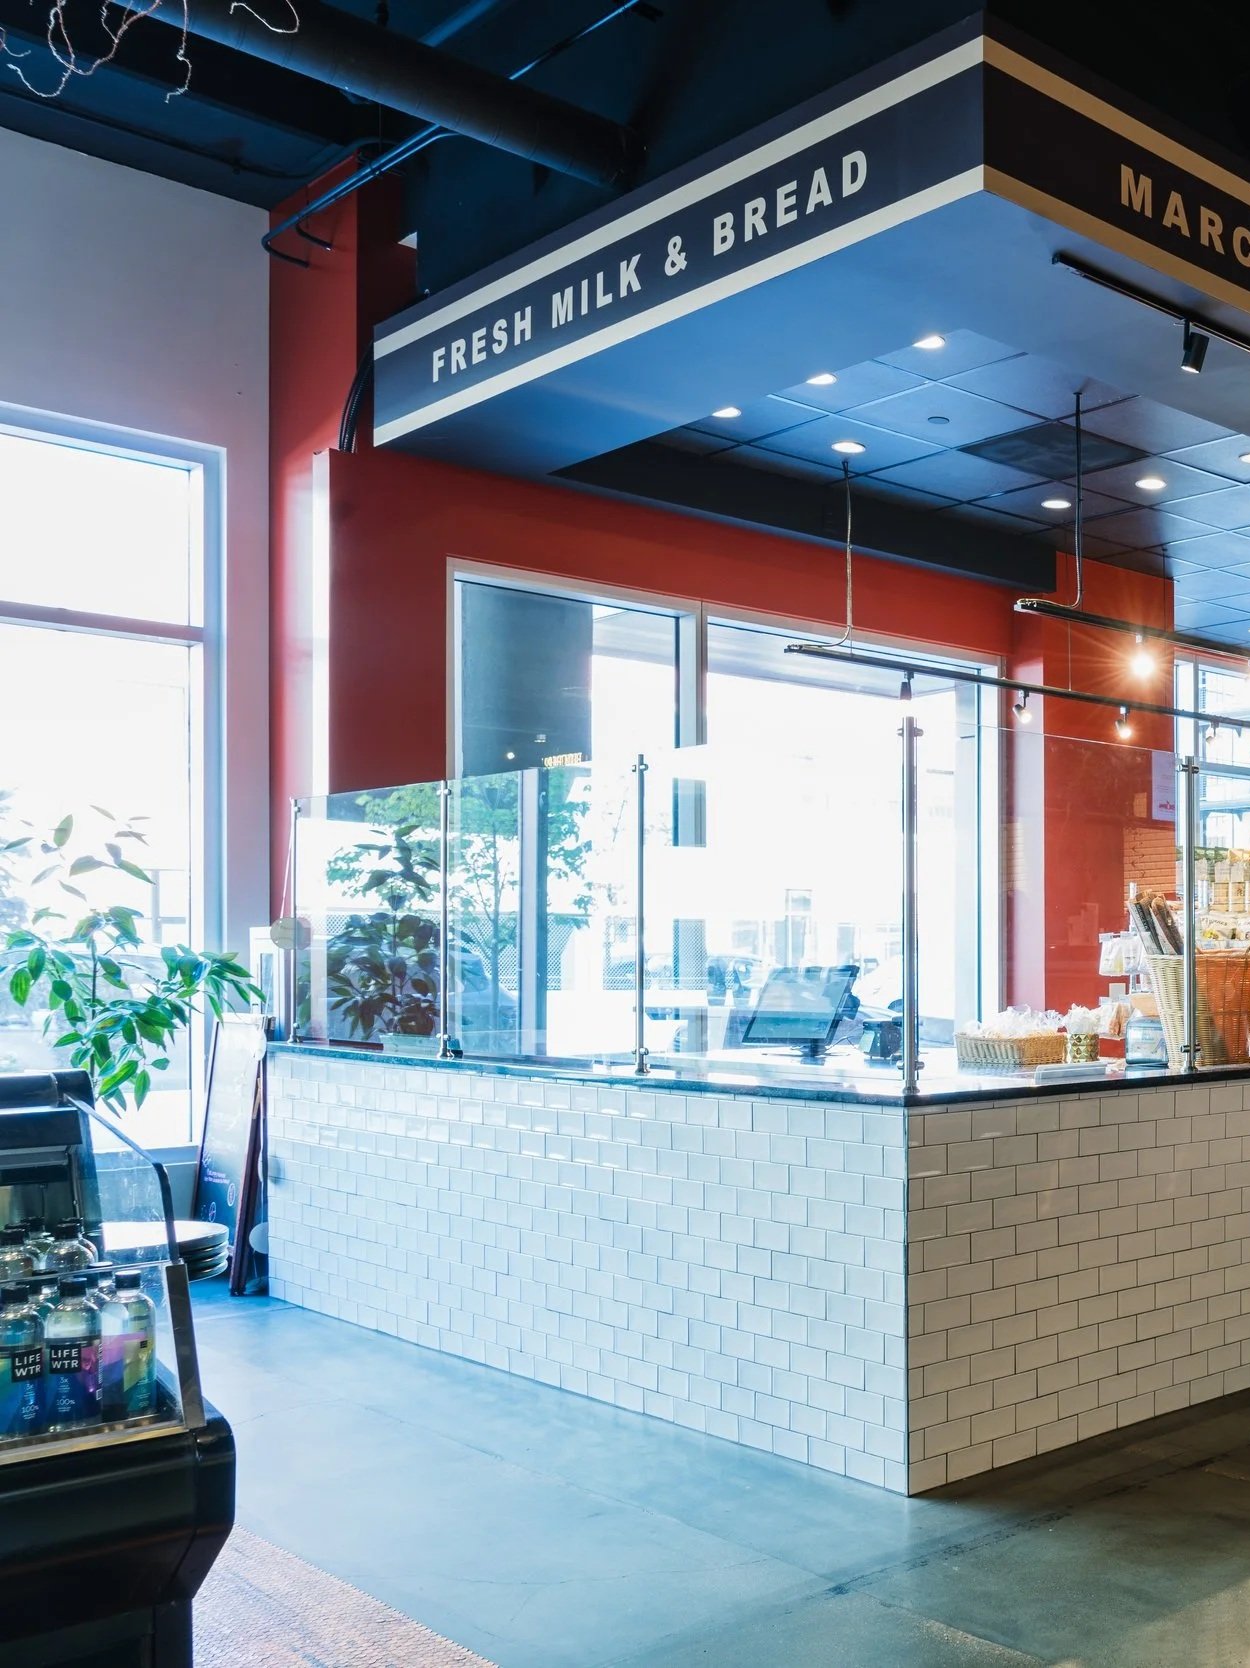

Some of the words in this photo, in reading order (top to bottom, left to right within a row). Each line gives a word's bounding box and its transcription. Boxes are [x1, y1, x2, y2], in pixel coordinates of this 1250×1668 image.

[433, 306, 532, 384] FRESH
[551, 254, 642, 329] MILK
[664, 235, 688, 277] &
[713, 150, 868, 257] BREAD
[15, 1353, 40, 1366] LIFE
[51, 1348, 79, 1358] LIFE
[15, 1364, 40, 1377] WTR
[51, 1359, 79, 1369] WTR
